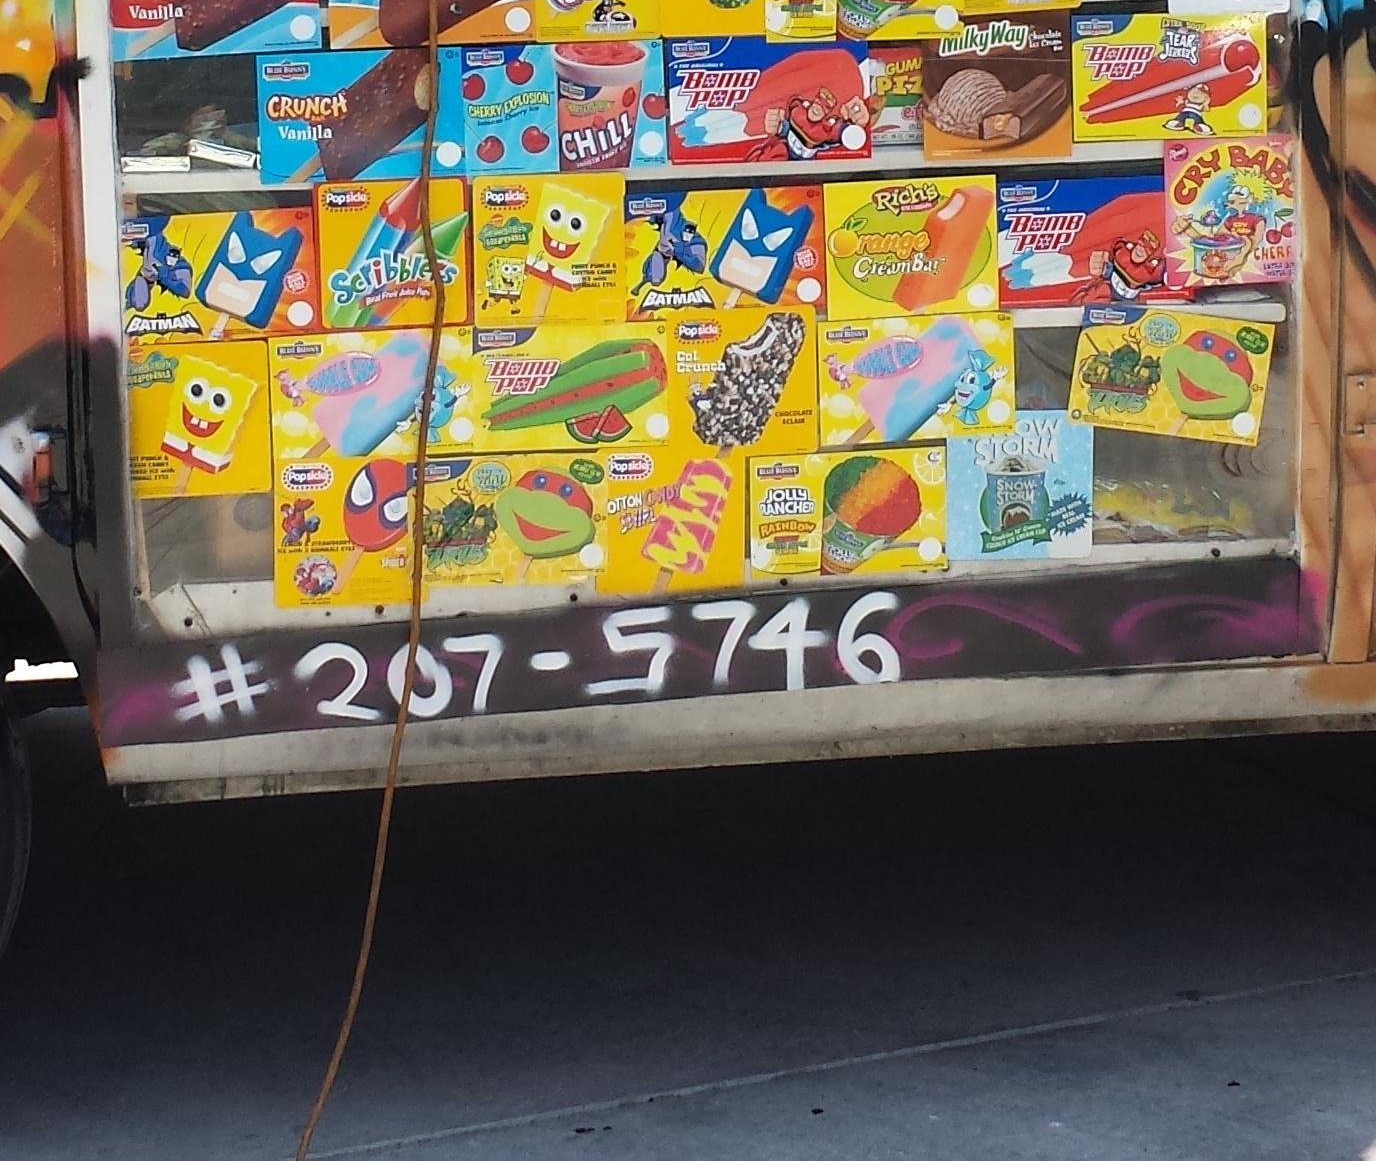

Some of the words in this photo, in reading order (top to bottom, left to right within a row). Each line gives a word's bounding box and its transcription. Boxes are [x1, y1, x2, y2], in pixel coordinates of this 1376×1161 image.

[128, 4, 185, 21] Vanilla
[1166, 30, 1196, 47] TEAR
[1083, 43, 1155, 63] BOMB
[680, 69, 759, 90] BOMB
[1091, 61, 1146, 81] POP
[267, 90, 348, 120] CRUNCH
[468, 101, 502, 118] CHERRY
[504, 91, 551, 114] EXPLOSION
[687, 88, 749, 110] POP
[278, 125, 332, 142] Vanilla
[1174, 148, 1222, 206] CRY
[1228, 145, 1293, 199] BABY
[325, 190, 367, 206] Popsicle
[485, 190, 525, 205] Popsicle
[874, 184, 940, 214] Rich's
[1006, 213, 1086, 233] BOMB
[1014, 232, 1075, 253] POP
[644, 288, 713, 308] BATMAN
[127, 313, 198, 335] BATMAN
[679, 325, 718, 338] Popsicle
[486, 359, 560, 377] BOMB
[676, 360, 726, 373] Crunch
[494, 375, 550, 396] POP
[775, 409, 814, 417] CHOCOLATE
[974, 438, 1057, 466] STORM
[287, 470, 328, 483] Popsicle
[610, 461, 651, 473] Popsicle
[644, 484, 681, 504] CANDY
[996, 479, 1035, 491] SNOW
[765, 489, 808, 503] JOLLY
[996, 490, 1035, 506] STORM
[759, 501, 815, 515] RANCHER
[619, 508, 657, 535] SWIRL
[759, 520, 816, 539] RAINBOW
